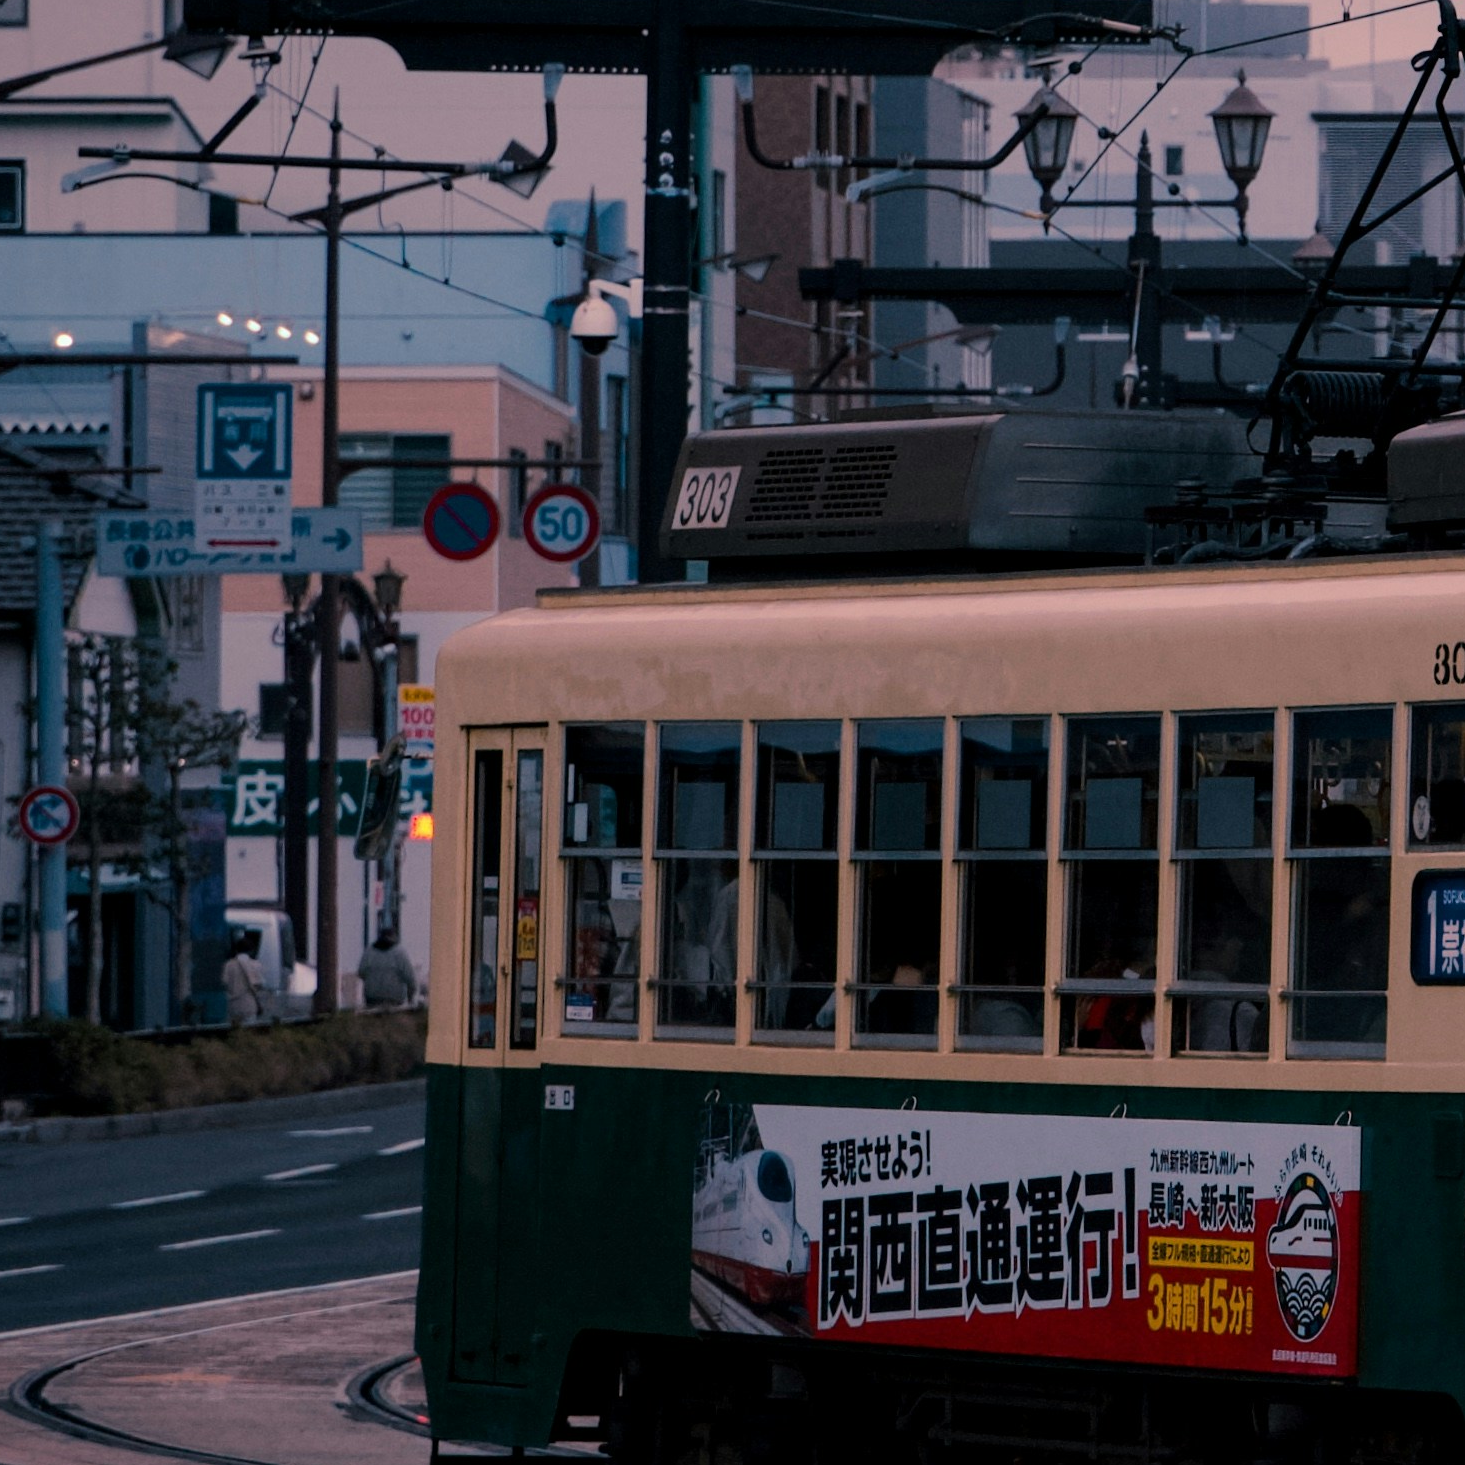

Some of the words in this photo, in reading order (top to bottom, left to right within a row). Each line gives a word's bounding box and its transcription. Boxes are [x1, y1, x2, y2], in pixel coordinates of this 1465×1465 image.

[539, 506, 582, 542] 50
[680, 472, 733, 526] 303
[1427, 889, 1438, 976] 1
[822, 1130, 931, 1188] 実現させよう！
[1150, 1149, 1255, 1175] 九州新幹線西九州ルート
[1149, 1182, 1255, 1229] 長崎～新大阪
[821, 1168, 1136, 1322] 関西直通運行！
[1147, 1273, 1245, 1335] 3時間15分
